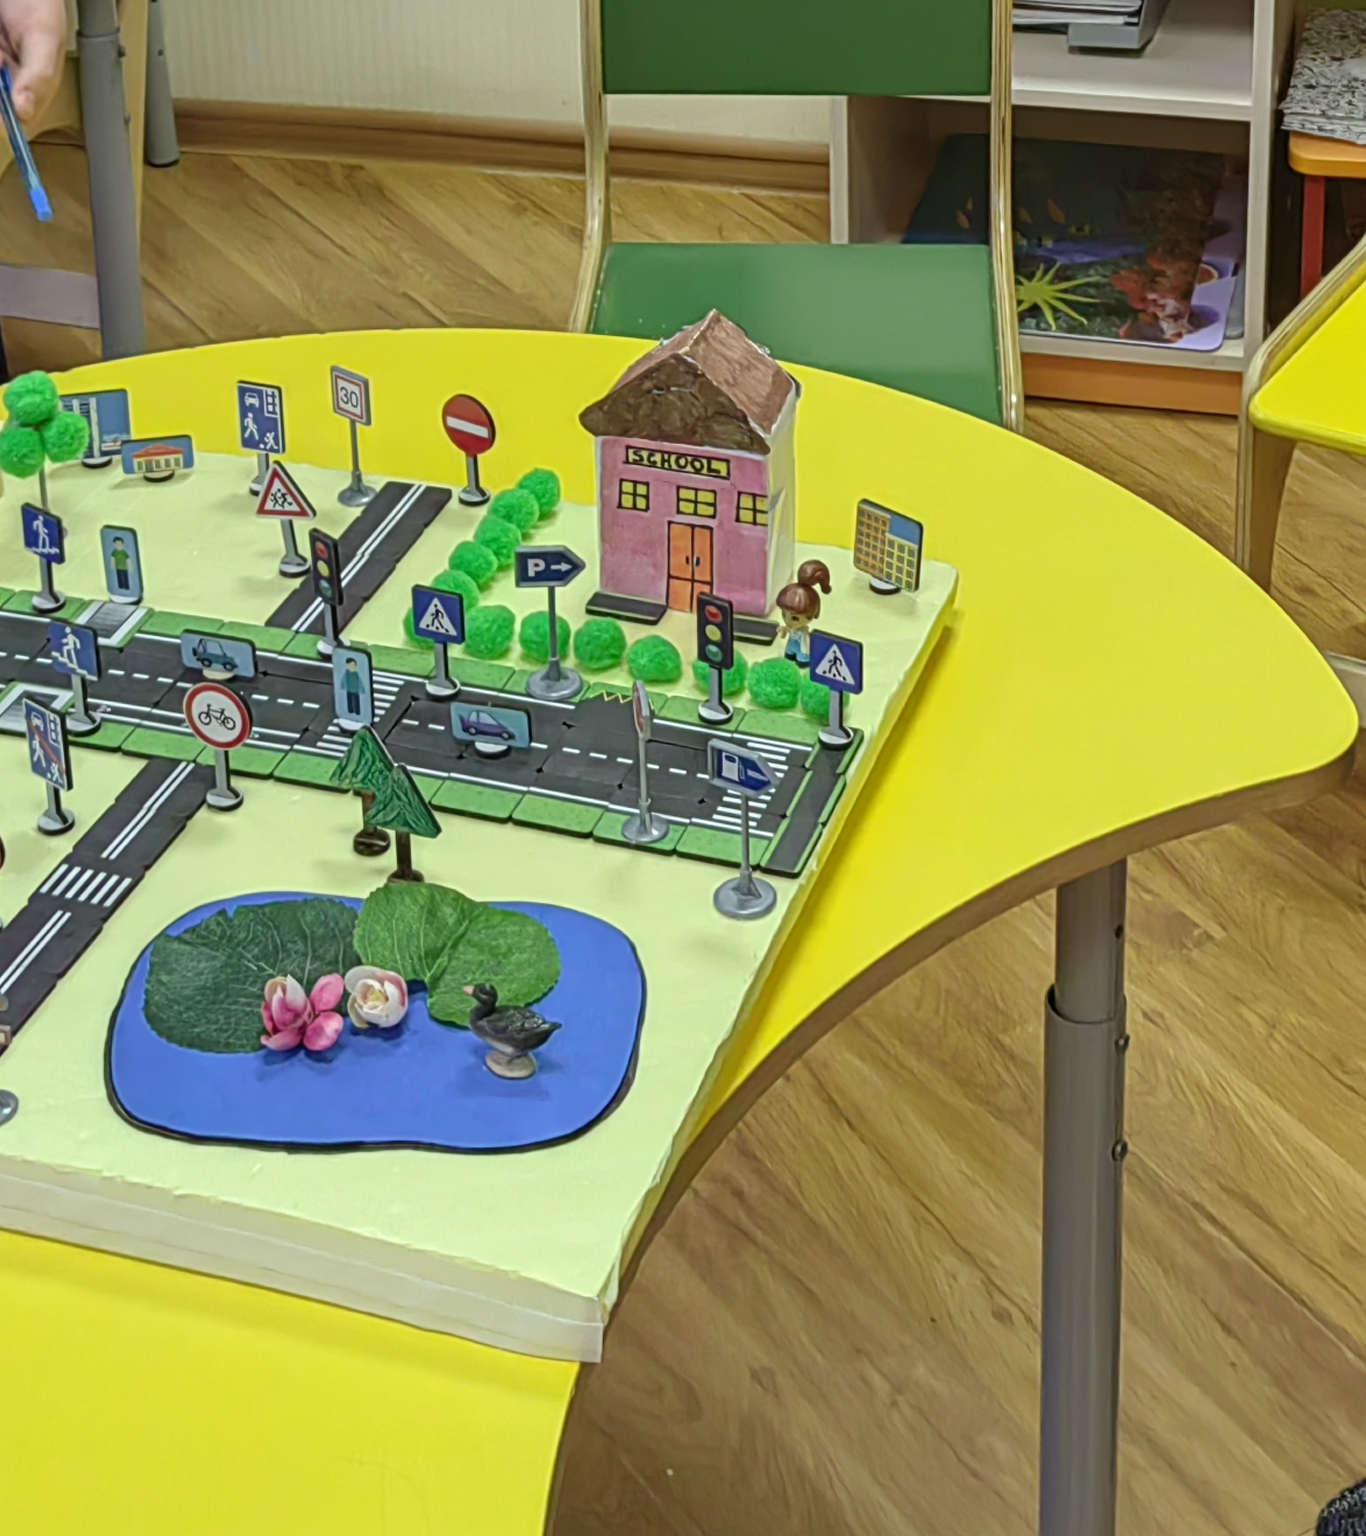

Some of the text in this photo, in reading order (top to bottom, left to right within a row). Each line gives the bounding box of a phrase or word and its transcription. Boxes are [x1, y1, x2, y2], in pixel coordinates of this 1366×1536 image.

[340, 386, 359, 408] 30
[631, 450, 722, 474] SCHOOL
[527, 558, 546, 577] P
